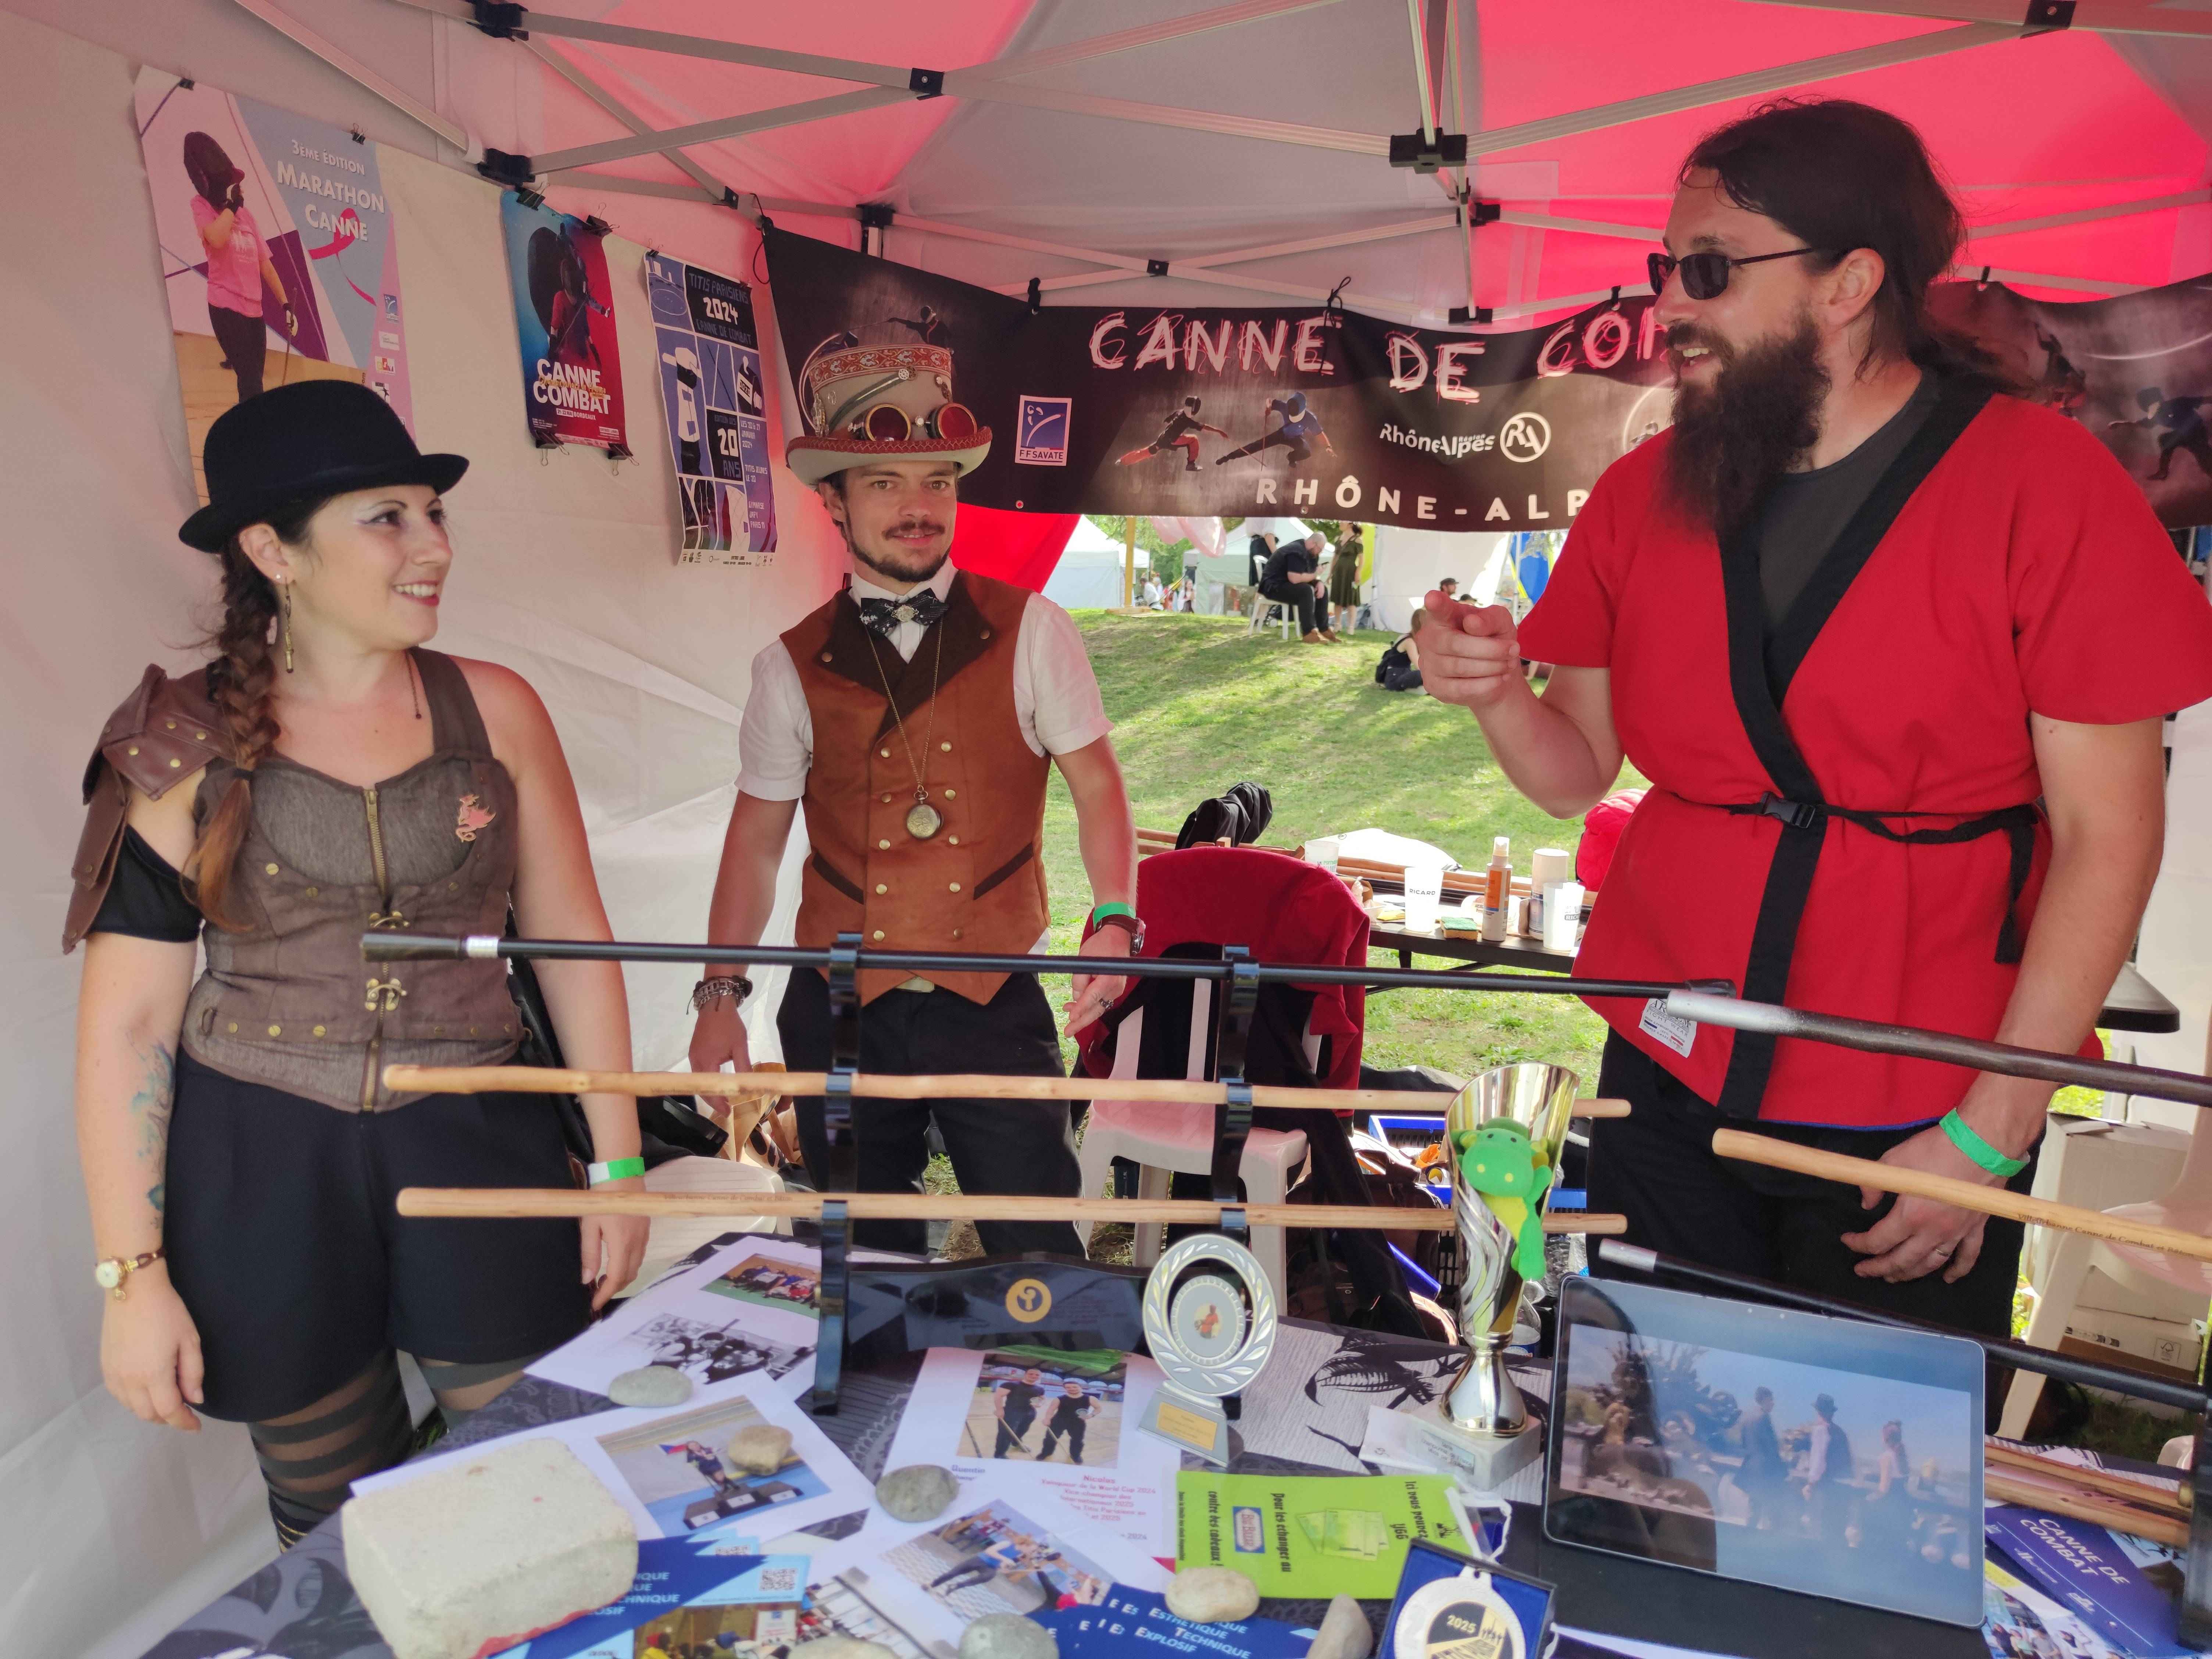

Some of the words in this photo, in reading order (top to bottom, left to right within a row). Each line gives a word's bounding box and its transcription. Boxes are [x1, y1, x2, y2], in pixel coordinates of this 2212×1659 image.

[292, 139, 320, 161] 3ÈME
[323, 148, 365, 175] ÉDITION
[277, 160, 385, 214] MARATHON
[305, 204, 368, 242] CANNE
[689, 273, 710, 292] TITIS
[711, 281, 749, 304] PARISIENS
[703, 297, 739, 325] 2024
[696, 319, 717, 336] CANNE
[719, 325, 728, 337] DE
[729, 328, 751, 345] COMBAT
[1089, 310, 1343, 376] CANNE
[1385, 331, 1486, 404] DE
[537, 359, 601, 389] CANNE
[533, 380, 611, 414] COMBAT
[574, 412, 596, 421] BORDEAUX
[717, 428, 739, 457] 20
[723, 460, 741, 478] ANS
[1646, 1009, 1667, 1024] FIGHT
[1671, 1022, 1688, 1037] WEAR
[2074, 1227, 2104, 1238] Canne
[2118, 1236, 2154, 1249] Combat
[952, 1464, 985, 1474] Quentin
[1083, 1475, 1116, 1484] Nicolas
[1405, 1481, 1417, 1489] Ici
[1101, 1506, 1135, 1515] Parisiens
[1208, 1491, 1221, 1513] contre
[1408, 1491, 1421, 1509] vous
[1209, 1515, 1221, 1527] des
[1410, 1511, 1428, 1538] pouvez
[1210, 1529, 1222, 1561] cadeaux
[1274, 1512, 1287, 1522] les
[1281, 1562, 1291, 1572] au
[2020, 1519, 2099, 1576] COMBAT
[2038, 1519, 2103, 1563] CANNE
[2098, 1566, 2130, 1584] DE
[1447, 1615, 1477, 1634] 2025
[1135, 1626, 1198, 1653] EXPLOSIF
[1175, 1626, 1252, 1659] TECHNIQUE
